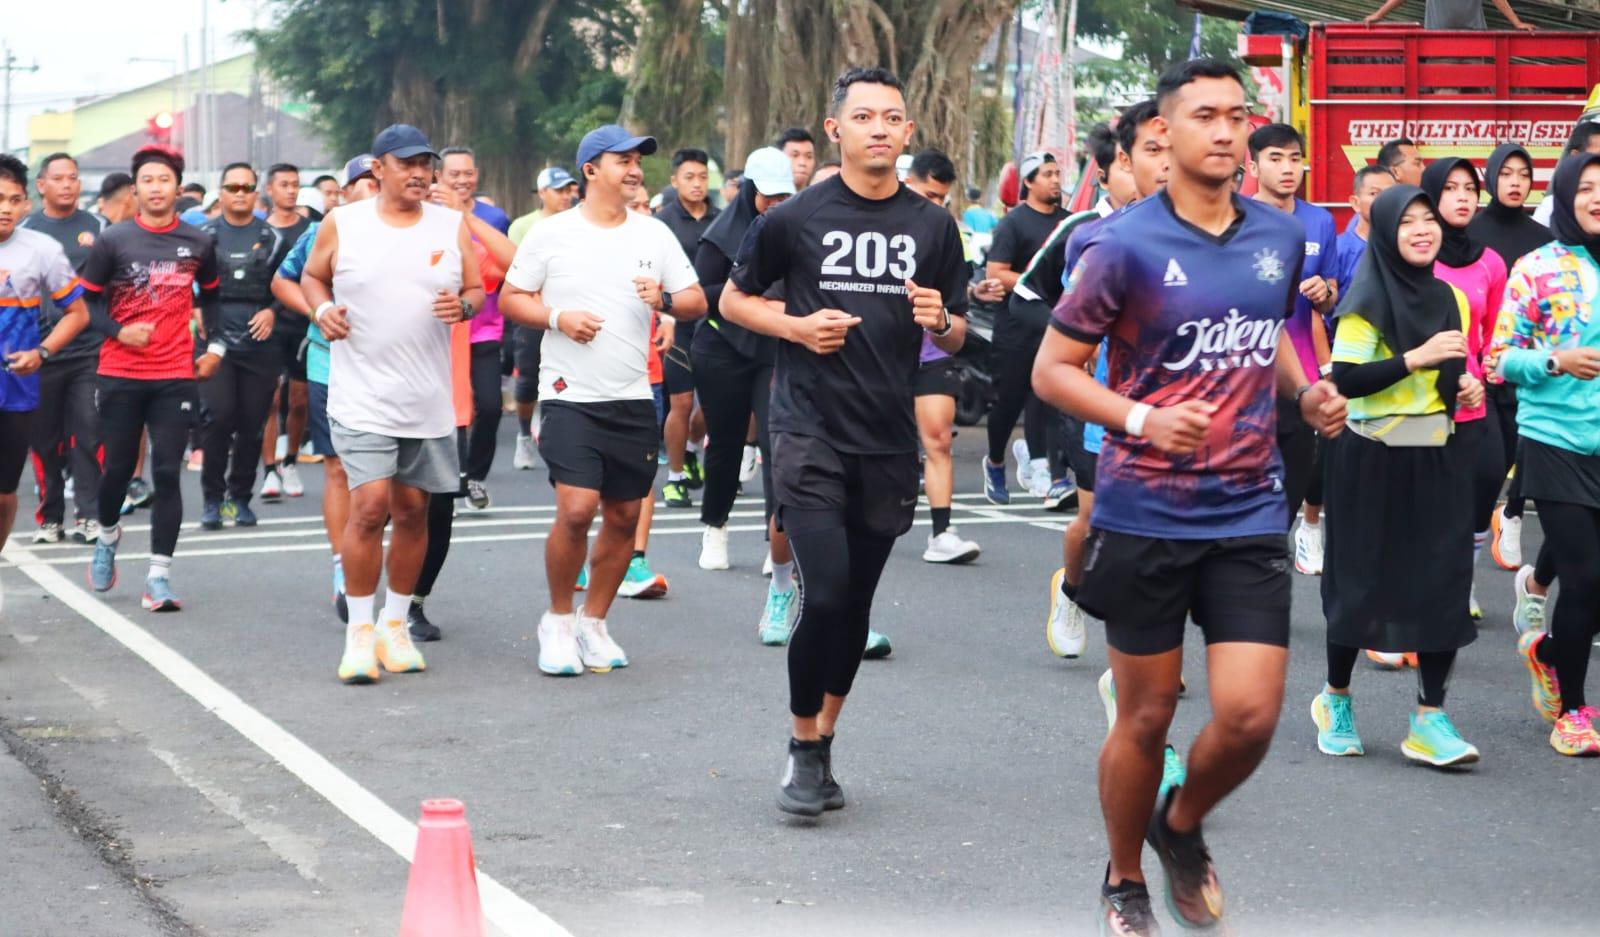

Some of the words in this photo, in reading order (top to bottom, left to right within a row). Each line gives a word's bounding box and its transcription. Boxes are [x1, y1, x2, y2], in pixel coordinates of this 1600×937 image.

[1352, 121, 1402, 139] THE
[1408, 121, 1529, 139] ULTIMATE
[820, 230, 917, 280] 203
[818, 280, 875, 293] MECHANIZED
[1161, 307, 1286, 372] Jateng
